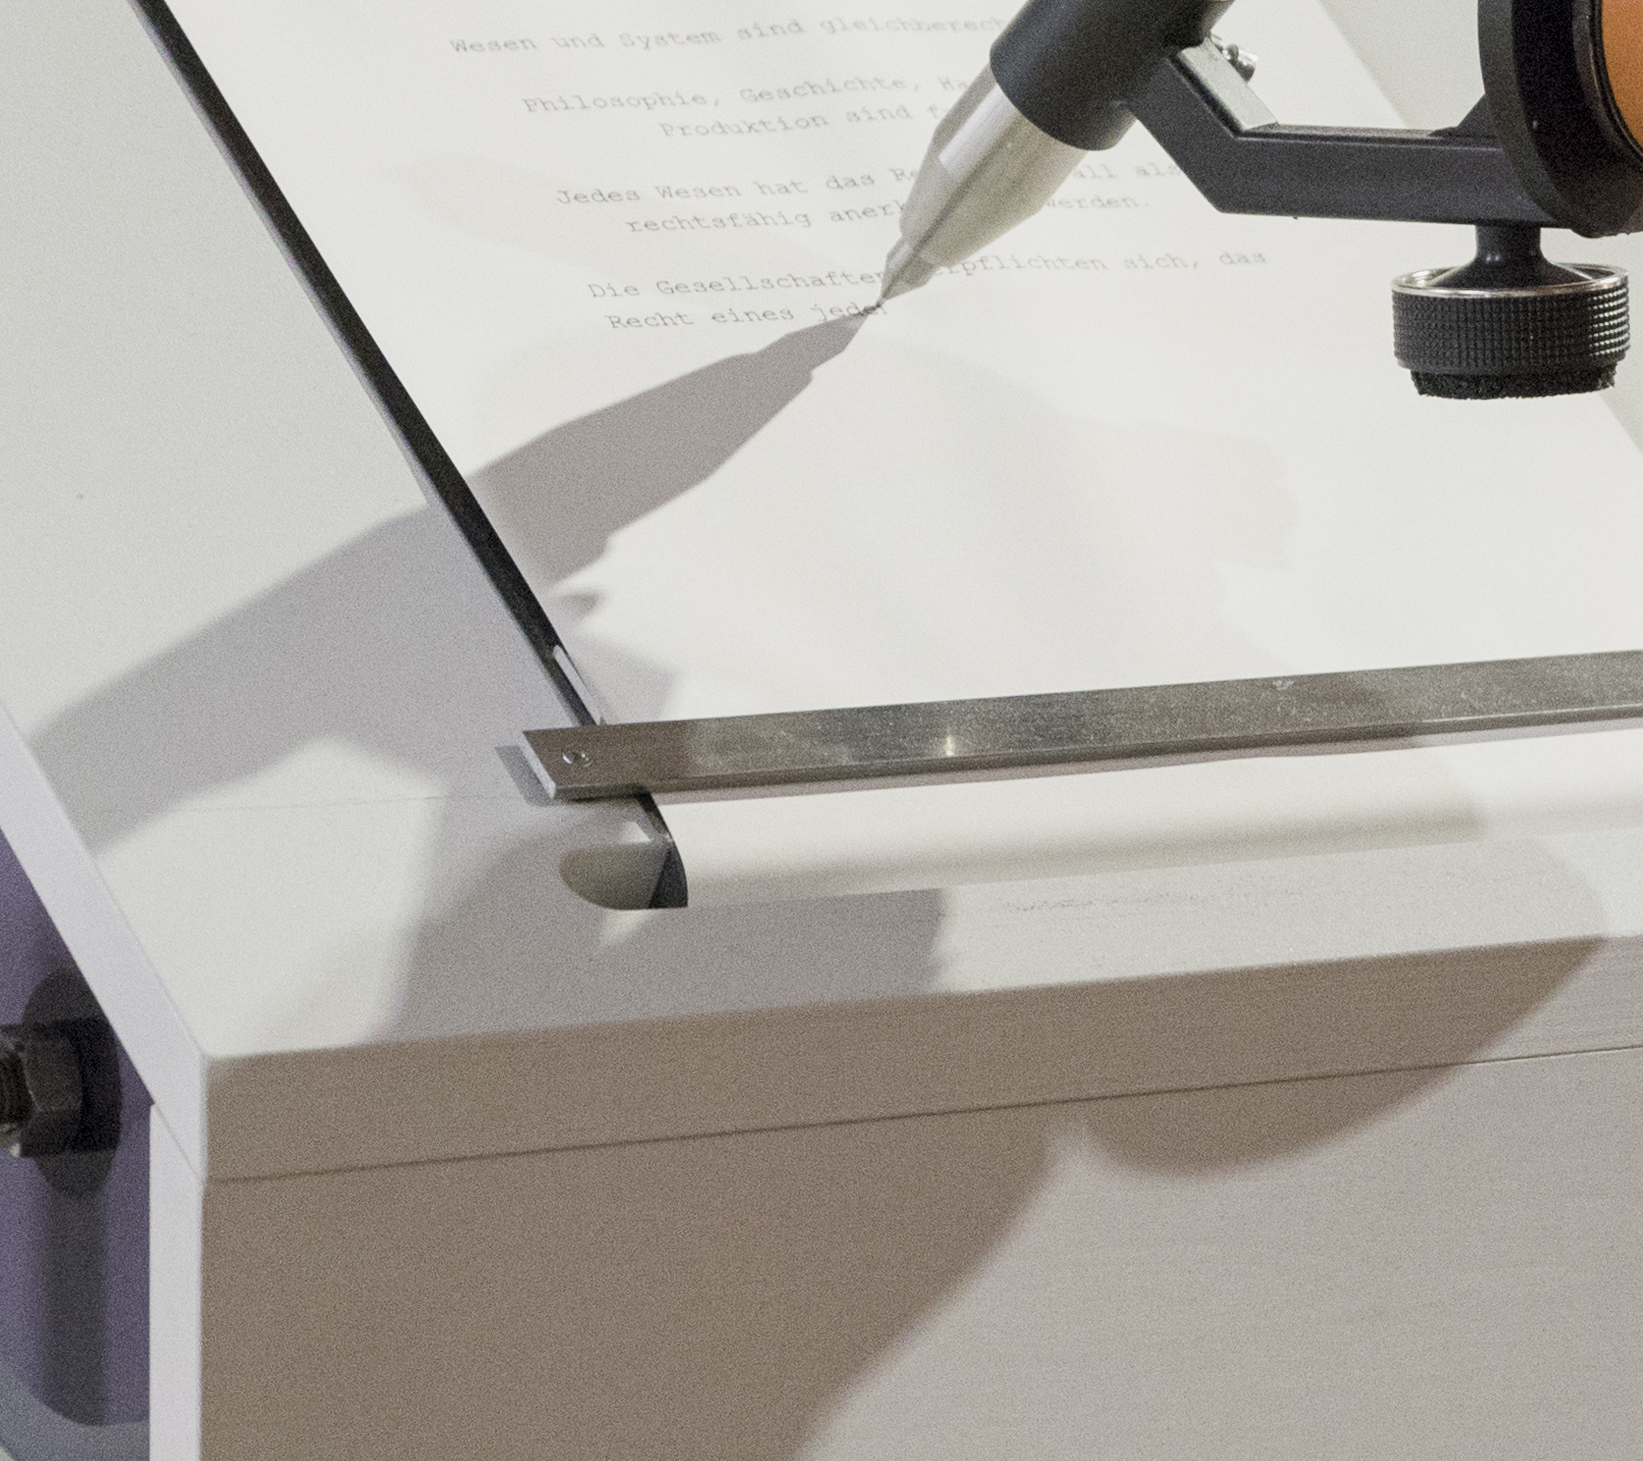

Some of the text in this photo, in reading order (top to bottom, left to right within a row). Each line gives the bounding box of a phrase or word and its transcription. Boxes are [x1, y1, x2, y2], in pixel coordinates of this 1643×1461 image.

[449, 37, 538, 54] Wesen
[551, 33, 606, 49] und
[618, 30, 722, 51] System
[736, 18, 806, 40] sind
[521, 91, 720, 113] Philosophie,
[739, 76, 919, 103] Geschichte,
[658, 114, 830, 138] Produktion
[845, 104, 914, 123] sind
[556, 188, 642, 205] Jedes
[654, 185, 742, 199] Wesen
[753, 180, 809, 196] hat
[825, 173, 876, 191] das
[624, 211, 813, 234] rechtsfähig
[587, 283, 641, 299] Die
[655, 265, 885, 296] Gesellschafte
[1123, 252, 1199, 270] sich,
[1218, 251, 1267, 266] das
[605, 311, 695, 330] Recht
[710, 306, 795, 325] eines
